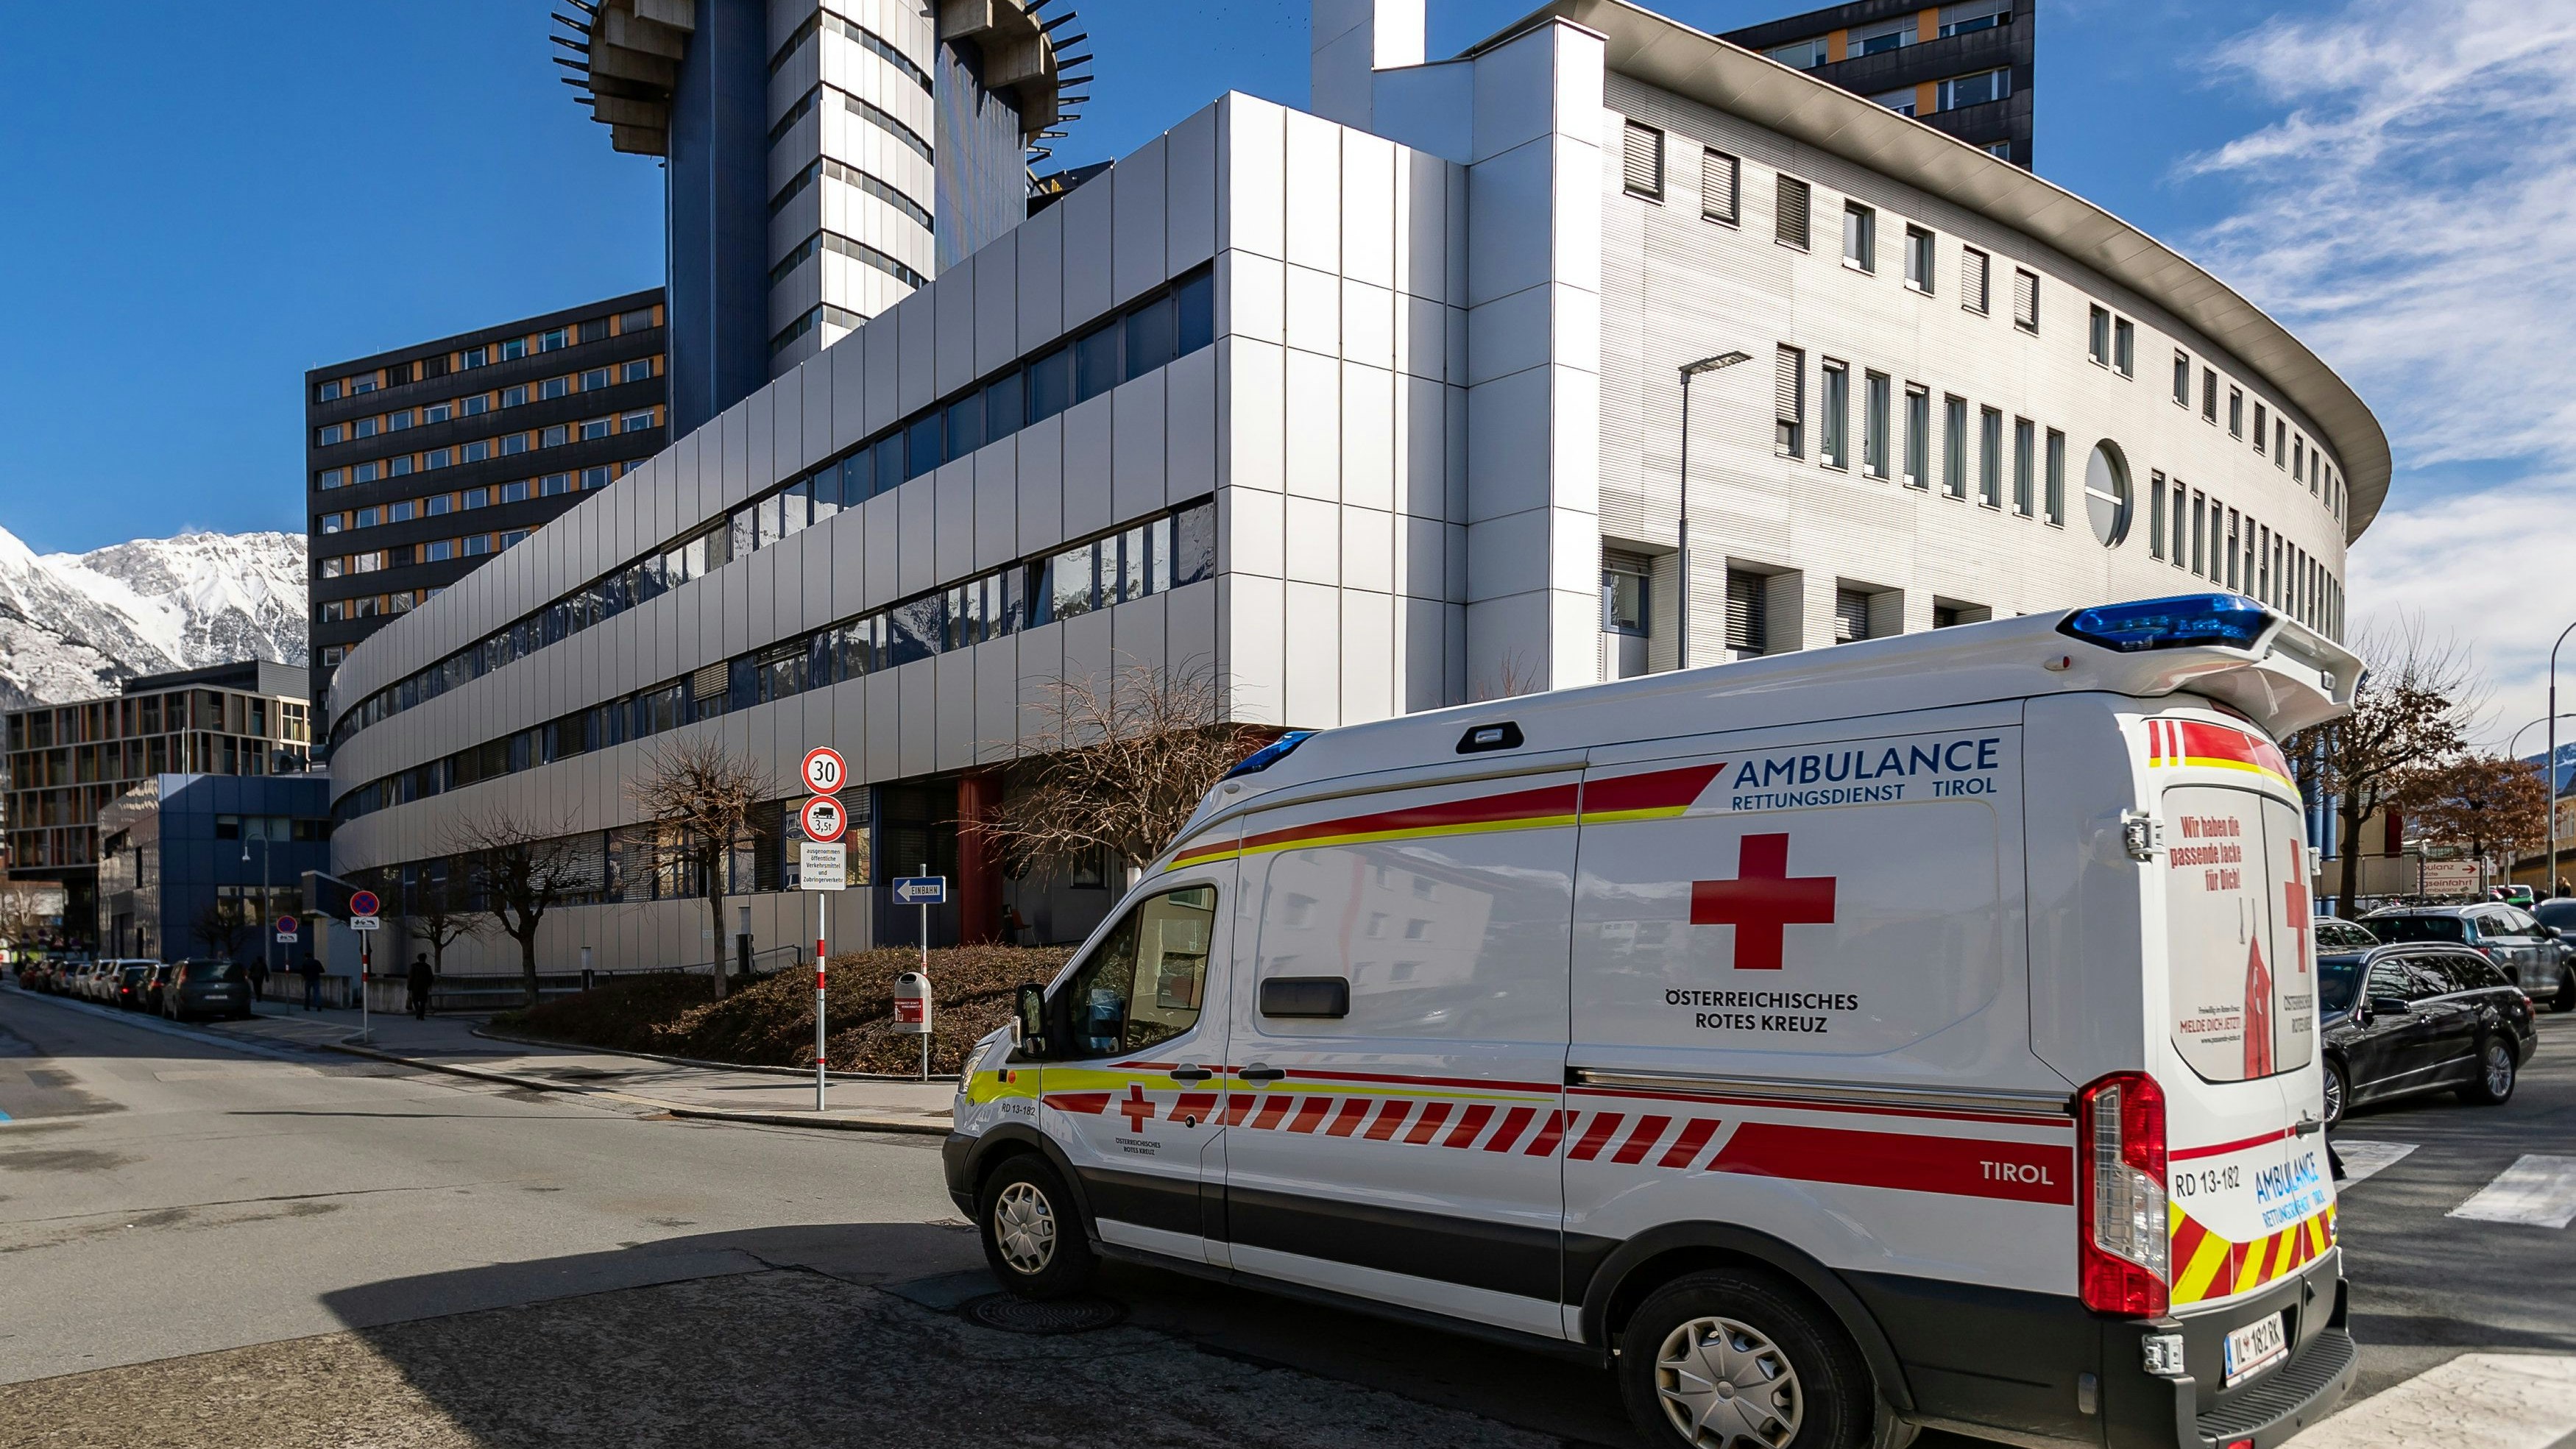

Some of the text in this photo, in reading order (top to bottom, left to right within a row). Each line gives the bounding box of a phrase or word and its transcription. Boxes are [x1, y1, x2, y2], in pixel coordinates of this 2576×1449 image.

[813, 760, 835, 782] 30
[1732, 737, 2000, 790] AMBULANCE
[1732, 777, 1997, 811] RETTUNGSDIENST TIROL
[815, 819, 832, 832] 3,5t
[2180, 816, 2200, 838] Wir
[2200, 815, 2228, 837] haben
[2169, 842, 2242, 869] passende Jacke
[911, 886, 938, 895] EINBAHN
[2205, 868, 2218, 891] für
[2423, 879, 2473, 888] gseinfahrt
[1665, 988, 1859, 1011] ÖSTERREICHISCHES
[1695, 1013, 1828, 1033] ROTES KREUZ
[2180, 1018, 2206, 1033] MELDE
[1001, 1103, 1036, 1116] RD 13-182
[1115, 1137, 1161, 1148] ÖSTERREICHISCHES
[1123, 1146, 1139, 1154] ROTES
[1979, 1161, 2054, 1186] TIROL
[2176, 1165, 2240, 1198] RD 13-182
[2255, 1151, 2319, 1205] AMBULANCE
[2251, 1323, 2269, 1356] 182
[2268, 1318, 2281, 1347] RK
